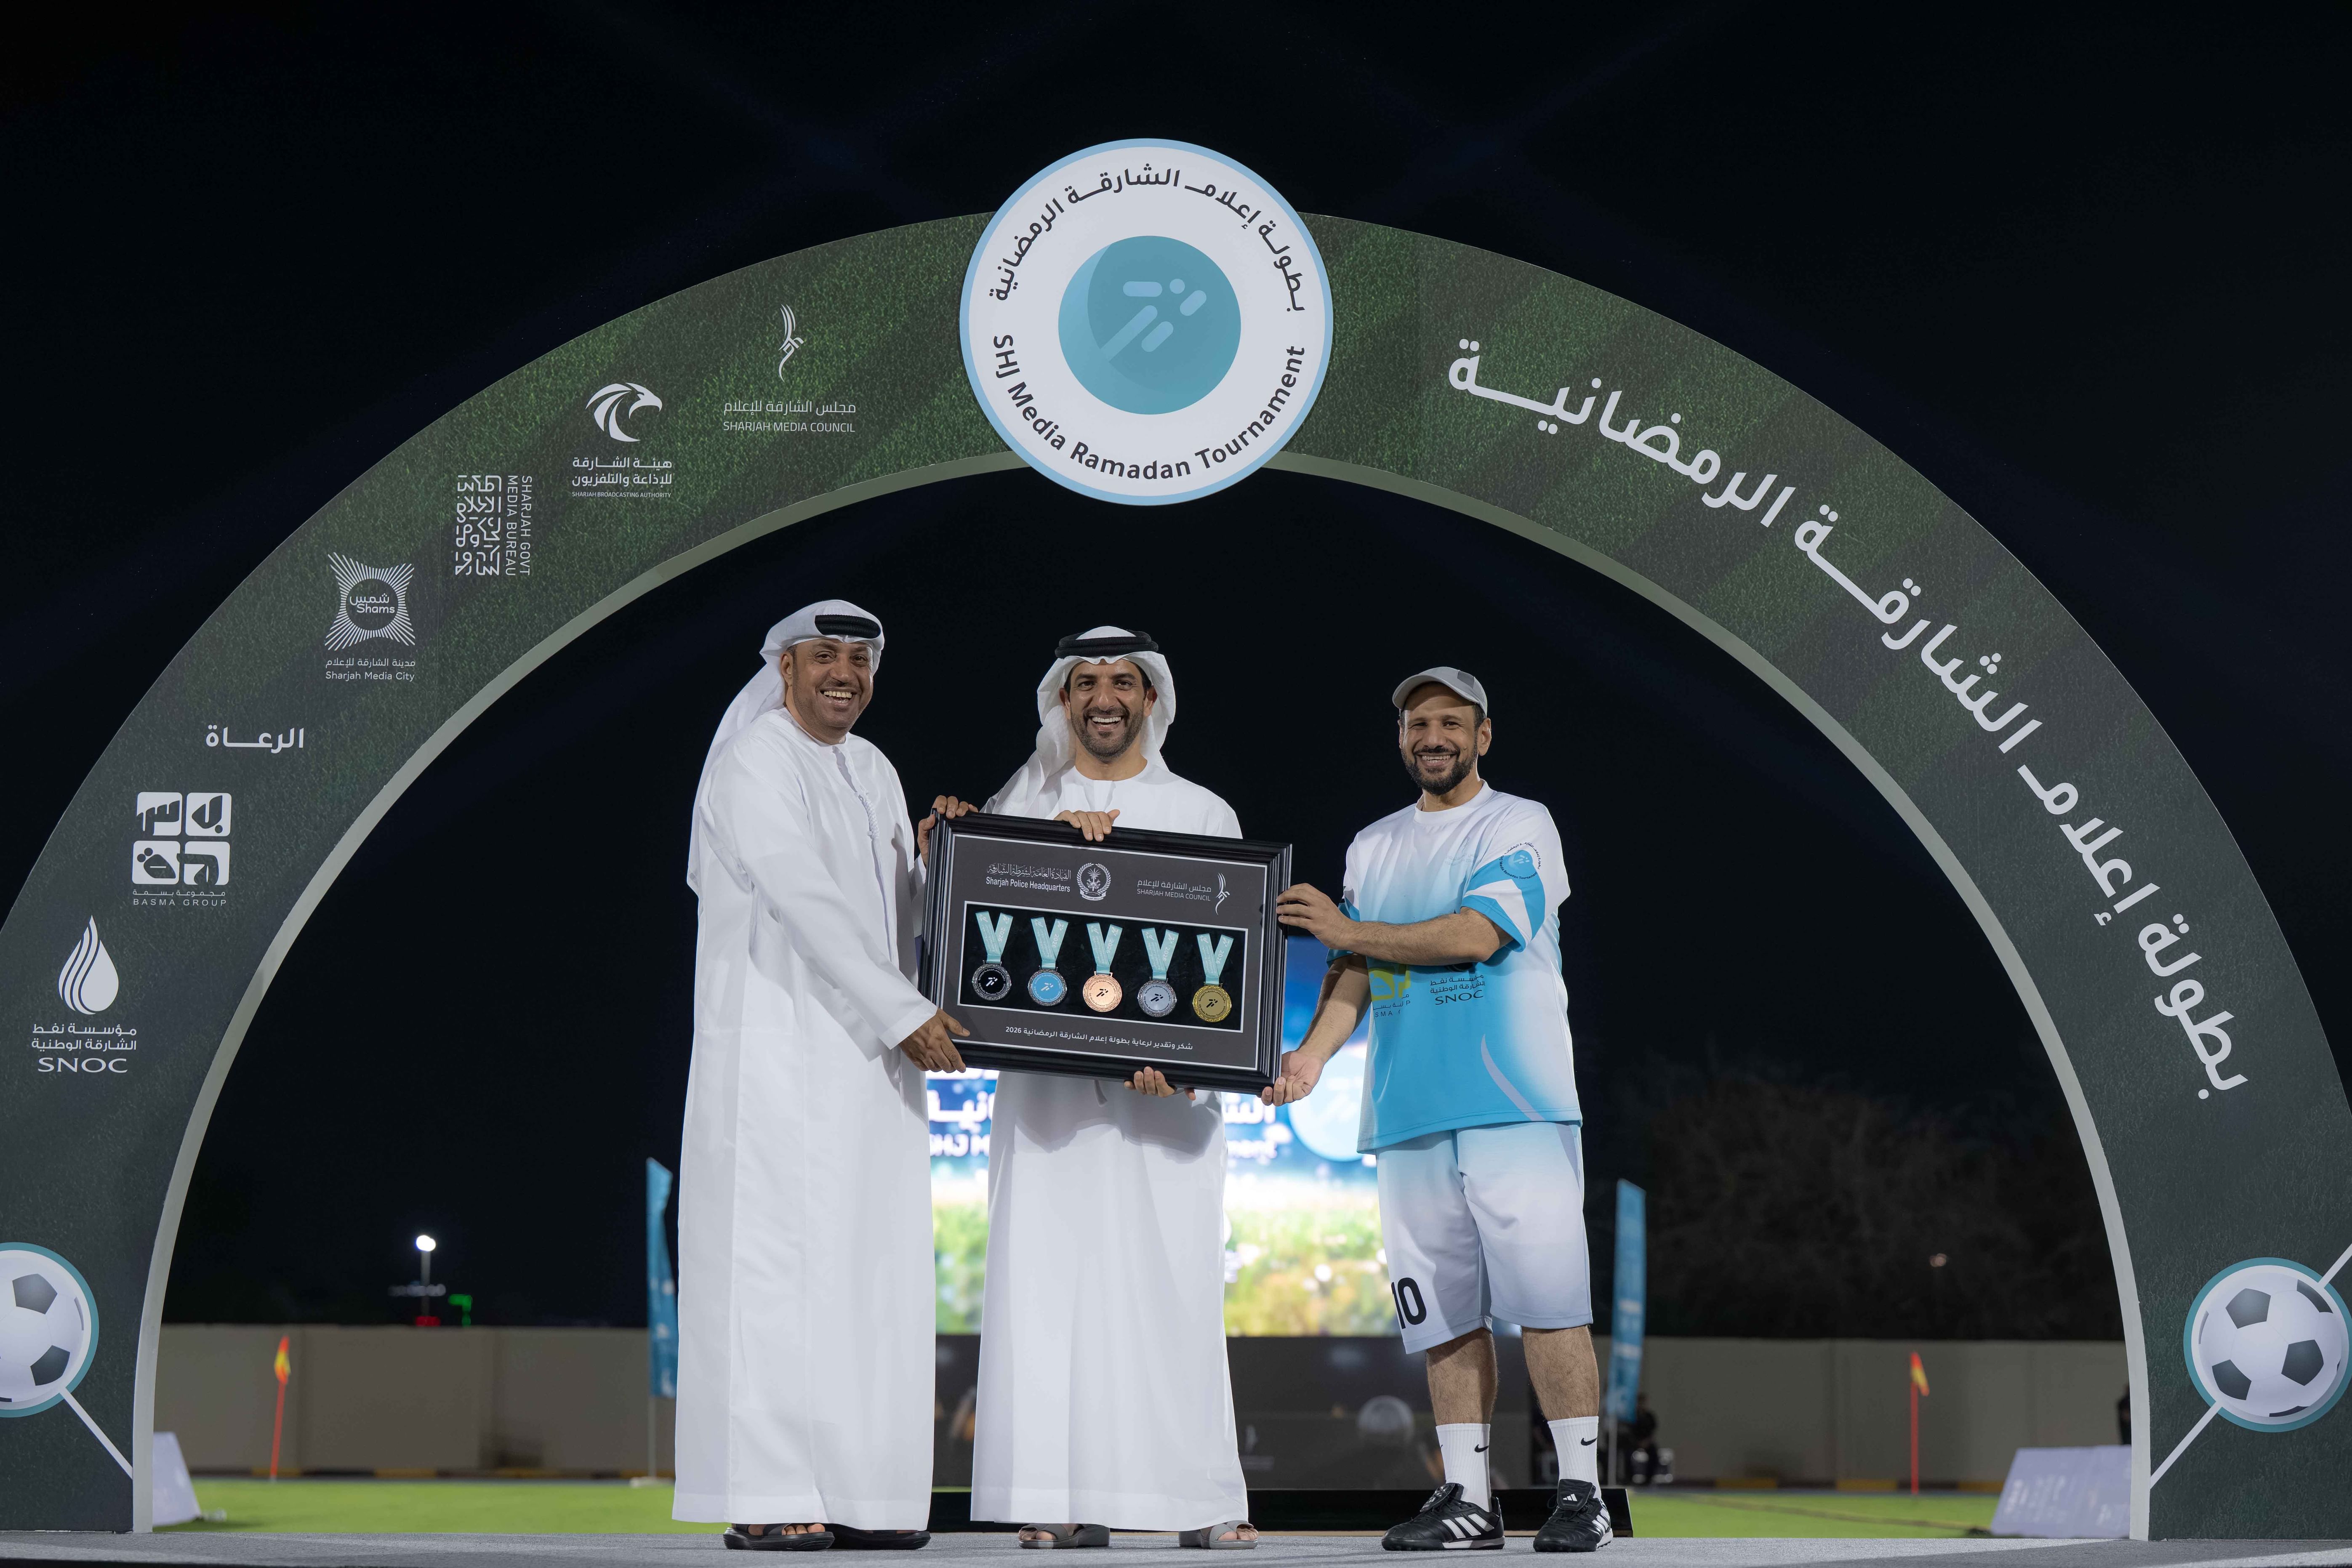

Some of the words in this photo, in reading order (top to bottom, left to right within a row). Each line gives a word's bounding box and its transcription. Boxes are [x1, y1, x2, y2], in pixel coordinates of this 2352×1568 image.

[1064, 163, 1180, 204] الشارقة
[989, 197, 1064, 301] الرمضانية
[1259, 220, 1305, 312] بطولة
[724, 400, 762, 415] للإعلام
[766, 400, 812, 415] الشارقة
[816, 402, 856, 415] مجلس
[994, 335, 1019, 380] SHJ
[1007, 382, 1066, 450] Media
[1070, 441, 1191, 479] Ramadan
[1196, 346, 1305, 469] Tournament
[723, 422, 770, 431] SHARJAH
[774, 422, 807, 431] MEDIA
[810, 423, 855, 432] COUNCIL
[1449, 339, 1795, 527] الرمضانية
[573, 456, 629, 470] الشارقة
[633, 458, 672, 471] هيئة
[572, 473, 629, 487] والتلفزيون
[633, 474, 672, 487] للإذاعة
[507, 475, 518, 517] MEDIA
[521, 476, 532, 536] SHARJAH
[506, 522, 517, 575] BUREAU
[519, 543, 530, 575] GOVT
[349, 593, 389, 605] شمس
[357, 604, 395, 613] Shams
[1795, 504, 2043, 754] الشارقة
[326, 658, 354, 668] للإعلام
[358, 658, 389, 668] الشارقة
[392, 659, 416, 668] مدينة
[325, 671, 360, 682] Sharjah
[396, 672, 415, 682] City
[206, 724, 304, 753] الرعاة
[1504, 870, 1518, 879] Ramadan
[986, 876, 1009, 887] Sharjah
[1010, 879, 1028, 888] Police
[1030, 880, 1070, 892] Headquarters
[1137, 879, 1159, 889] للإعلام
[1161, 881, 1187, 890] الشارقة
[1430, 985, 1457, 995] الوطنية
[1459, 980, 1485, 990] الشارقة
[1435, 990, 1484, 1005] SNOC
[2138, 913, 2248, 1099] بطولة
[32, 1023, 64, 1033] نفط
[68, 1023, 137, 1036] مؤسسة
[1023, 1028, 1057, 1038] الرمضانية
[1059, 1031, 1087, 1040] الشارقة
[1089, 1035, 1107, 1044] إعلام
[1109, 1036, 1130, 1044] بطولة
[31, 1038, 82, 1052] الوطنية
[85, 1038, 137, 1052] الشارقة
[1132, 1038, 1152, 1049] لرعاية
[1153, 1041, 1175, 1049] وتقدير
[1176, 1042, 1193, 1050] شكر
[38, 1057, 128, 1073] SNOC
[1391, 1277, 1427, 1329] 10
